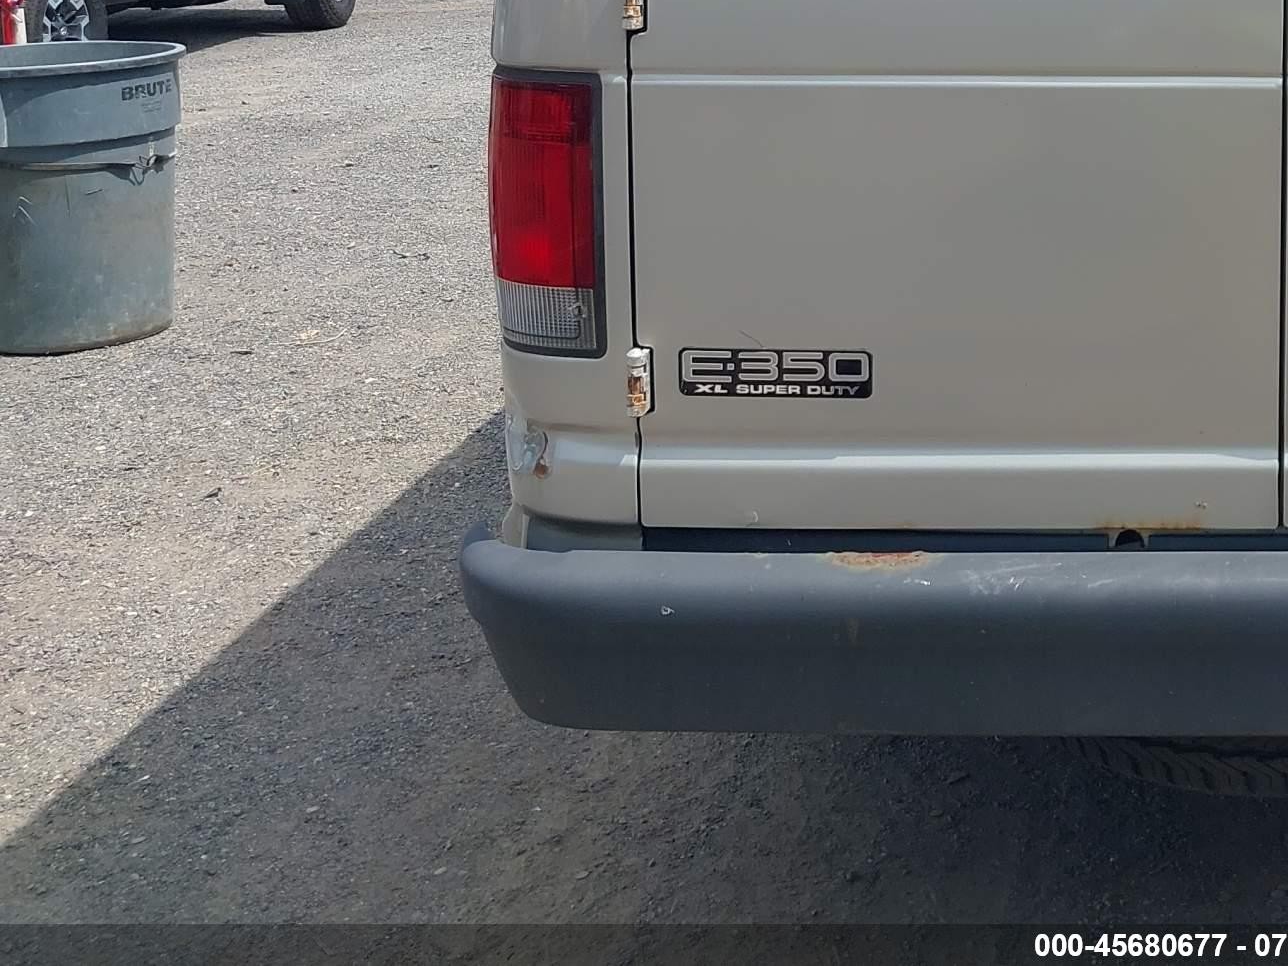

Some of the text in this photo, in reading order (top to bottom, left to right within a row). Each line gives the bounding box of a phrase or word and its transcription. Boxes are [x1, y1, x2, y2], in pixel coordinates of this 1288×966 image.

[121, 78, 172, 101] BRUTE
[693, 383, 860, 396] XL SUPER DUTY
